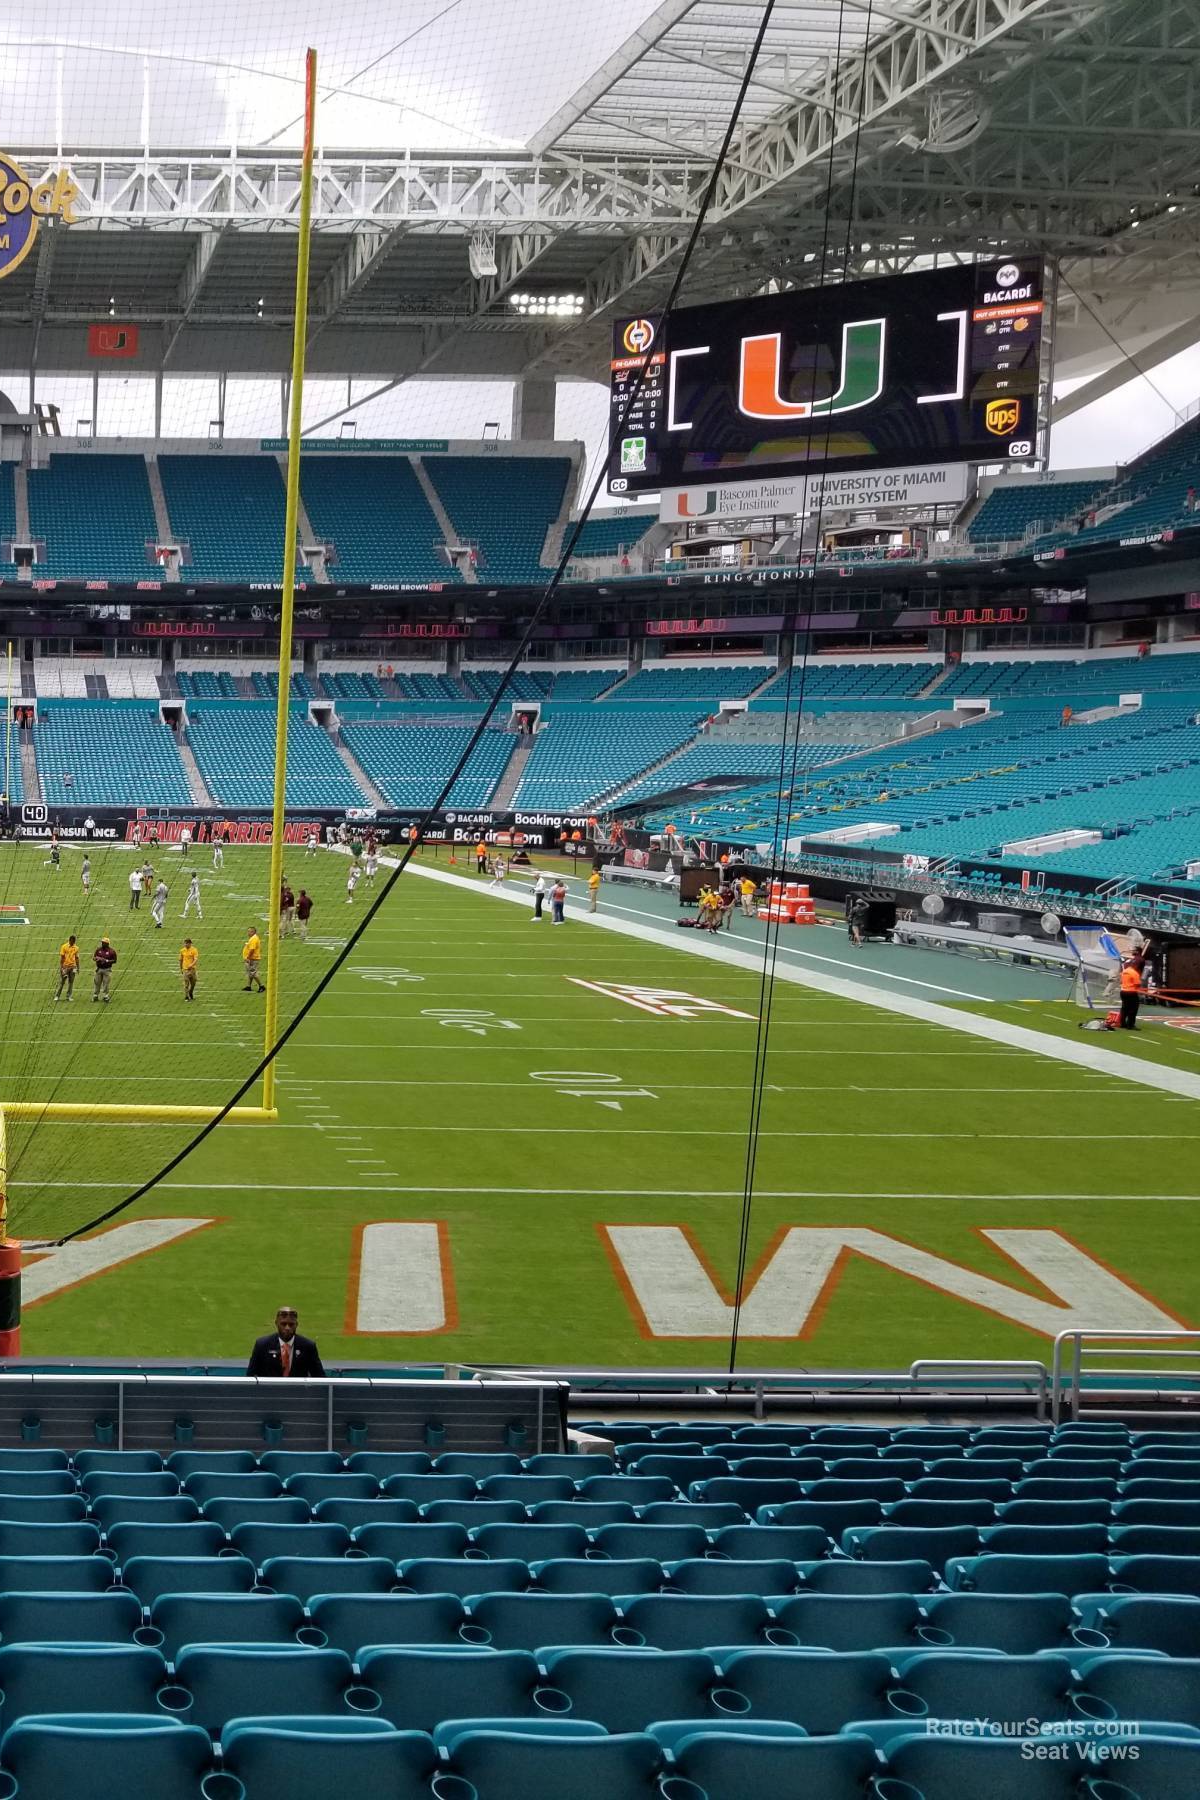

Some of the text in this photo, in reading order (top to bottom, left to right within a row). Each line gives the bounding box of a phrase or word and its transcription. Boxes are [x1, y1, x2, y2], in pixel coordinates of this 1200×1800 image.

[984, 283, 1032, 303] BACARDÍ
[988, 407, 1018, 431] ups
[1011, 443, 1029, 454] CC
[612, 481, 627, 490] CC
[810, 471, 946, 493] UNIVERSITY OF MIAMI
[719, 485, 797, 501] Bascom Palmer
[810, 489, 908, 508] HEALTH SYSTEM
[611, 506, 628, 516] 309
[719, 498, 780, 513] Eye Institute
[1146, 533, 1162, 543] SAPP
[704, 572, 743, 584] RING
[370, 583, 400, 591] JEROME
[401, 583, 429, 591] BROWN
[26, 806, 44, 820] 40
[457, 812, 493, 824] BACARDÍ
[514, 813, 588, 829] Booking.com
[419, 1008, 524, 1031] 20
[528, 1070, 660, 1099] 10
